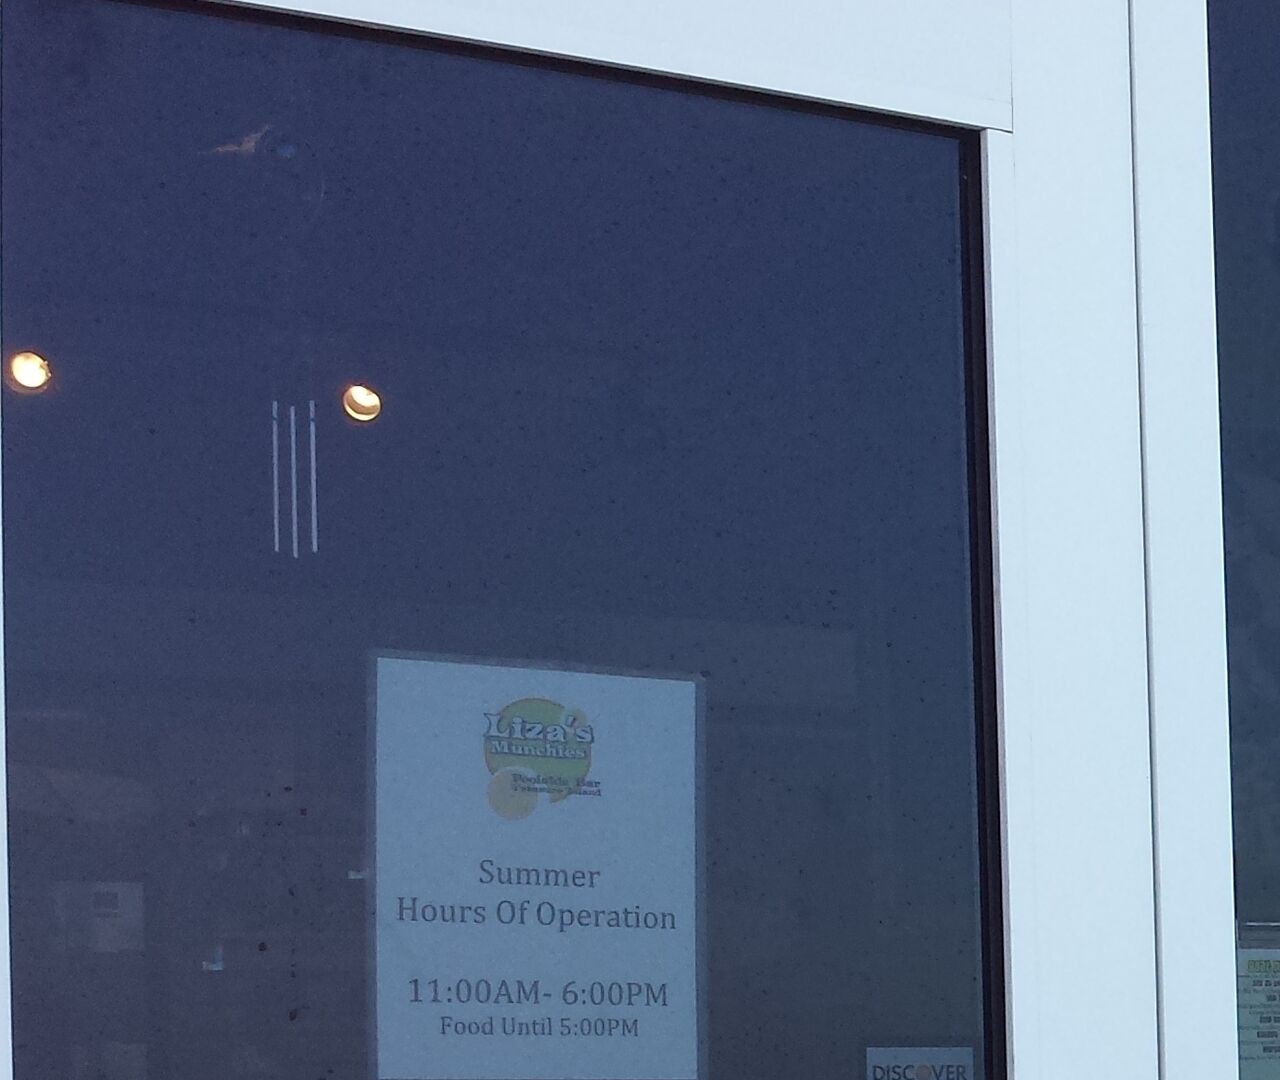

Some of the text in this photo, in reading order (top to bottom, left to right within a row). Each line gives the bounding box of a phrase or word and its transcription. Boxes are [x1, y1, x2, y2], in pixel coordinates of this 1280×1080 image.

[483, 712, 594, 744] Liza's
[490, 740, 587, 759] Munchies
[478, 859, 600, 888] Summer
[396, 897, 677, 932] Hours Of Operation
[562, 980, 669, 1007] 6:00PM
[440, 1015, 639, 1038] Food Until 5:00PM
